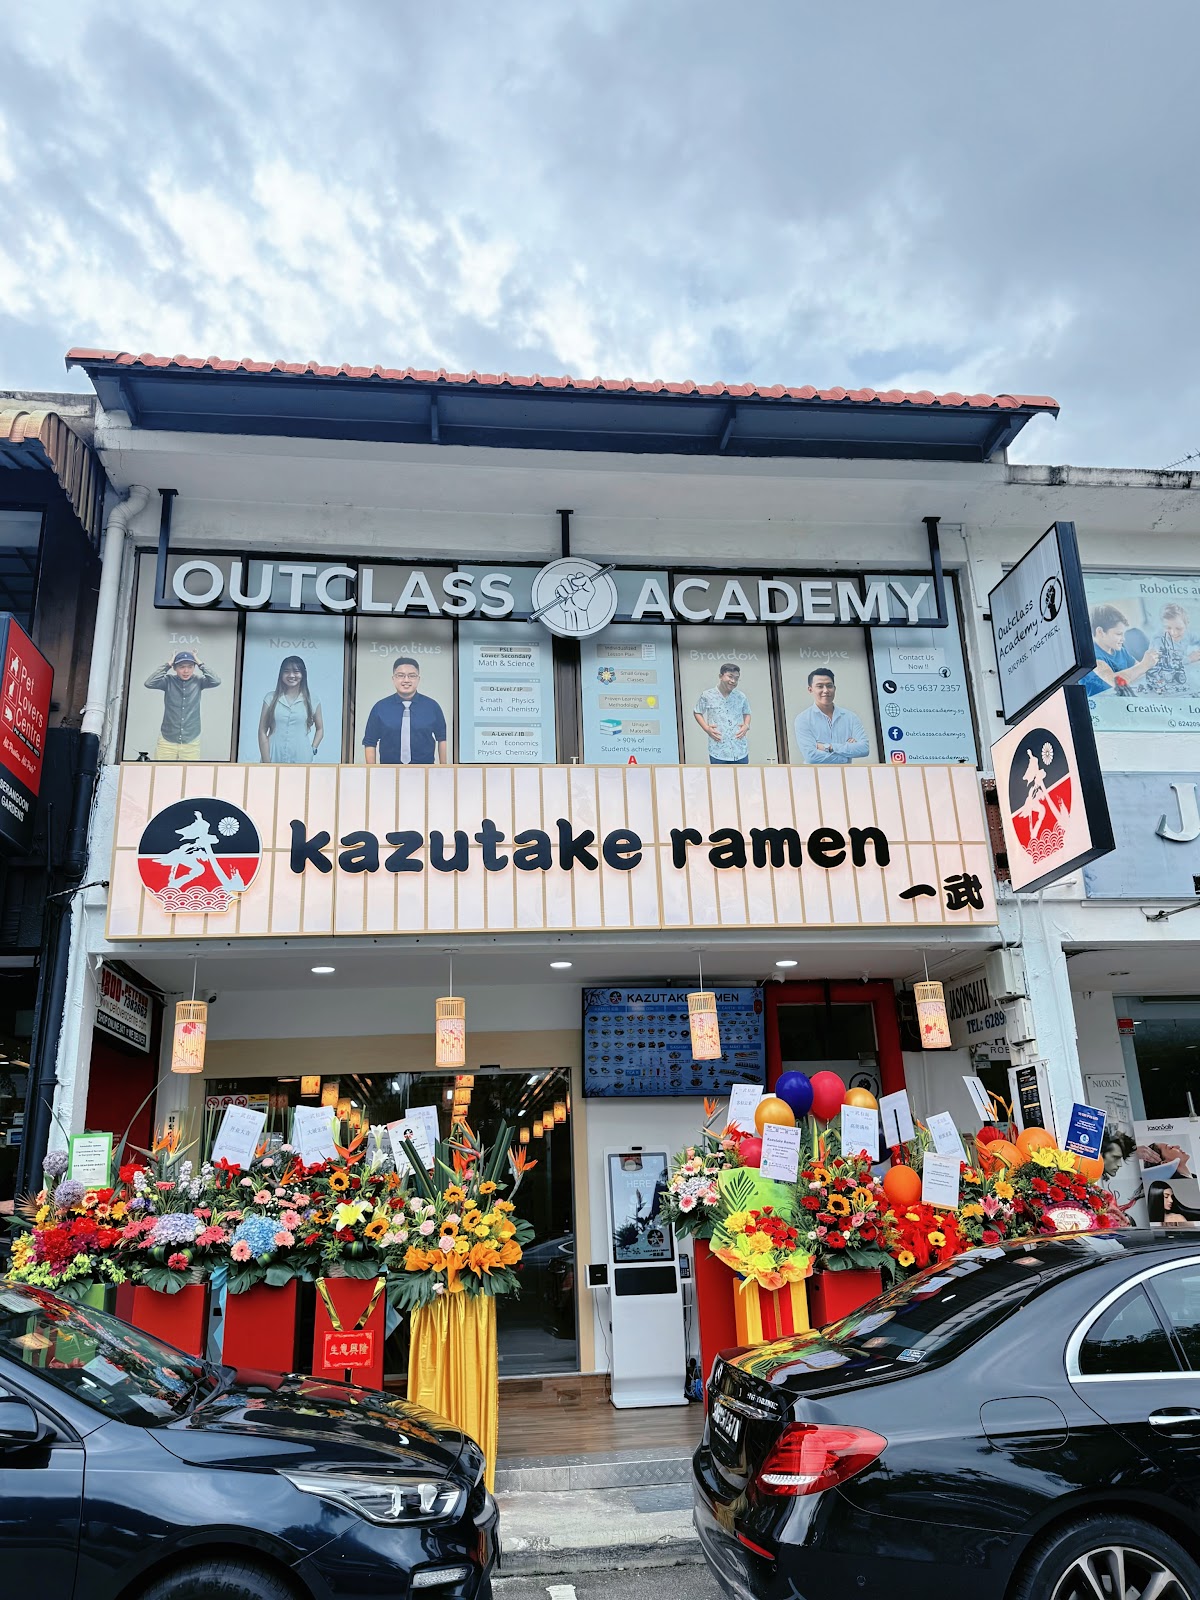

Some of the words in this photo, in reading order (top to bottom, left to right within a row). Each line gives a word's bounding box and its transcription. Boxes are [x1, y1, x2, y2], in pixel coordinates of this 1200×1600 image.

[172, 560, 515, 617] OUTCLASS
[631, 578, 931, 624] ACADEMY
[1140, 583, 1188, 595] Robotics
[998, 600, 1033, 640] Outclass
[169, 632, 201, 645] Ian
[269, 637, 318, 650] Novia
[1000, 619, 1038, 661] Academy
[370, 640, 442, 658] Ignatius
[690, 648, 759, 661] Brandon
[800, 647, 849, 664] Wayne
[21, 669, 35, 696] Pet
[899, 684, 915, 692] +65
[917, 684, 938, 692] 9637
[940, 684, 961, 692] 2357
[18, 686, 43, 729] Lovers
[1126, 703, 1173, 715] Creativity
[505, 749, 539, 757] Chemistry
[628, 755, 638, 765] A
[1, 795, 25, 822] GARDENS
[289, 818, 643, 873] kazutake
[671, 826, 891, 869] ramen
[898, 872, 985, 912] 一武
[949, 977, 991, 1021] JASONSALLY
[967, 1018, 984, 1034] TEL:
[1092, 1079, 1121, 1088] NIOXIN
[627, 1180, 651, 1188] HERE
